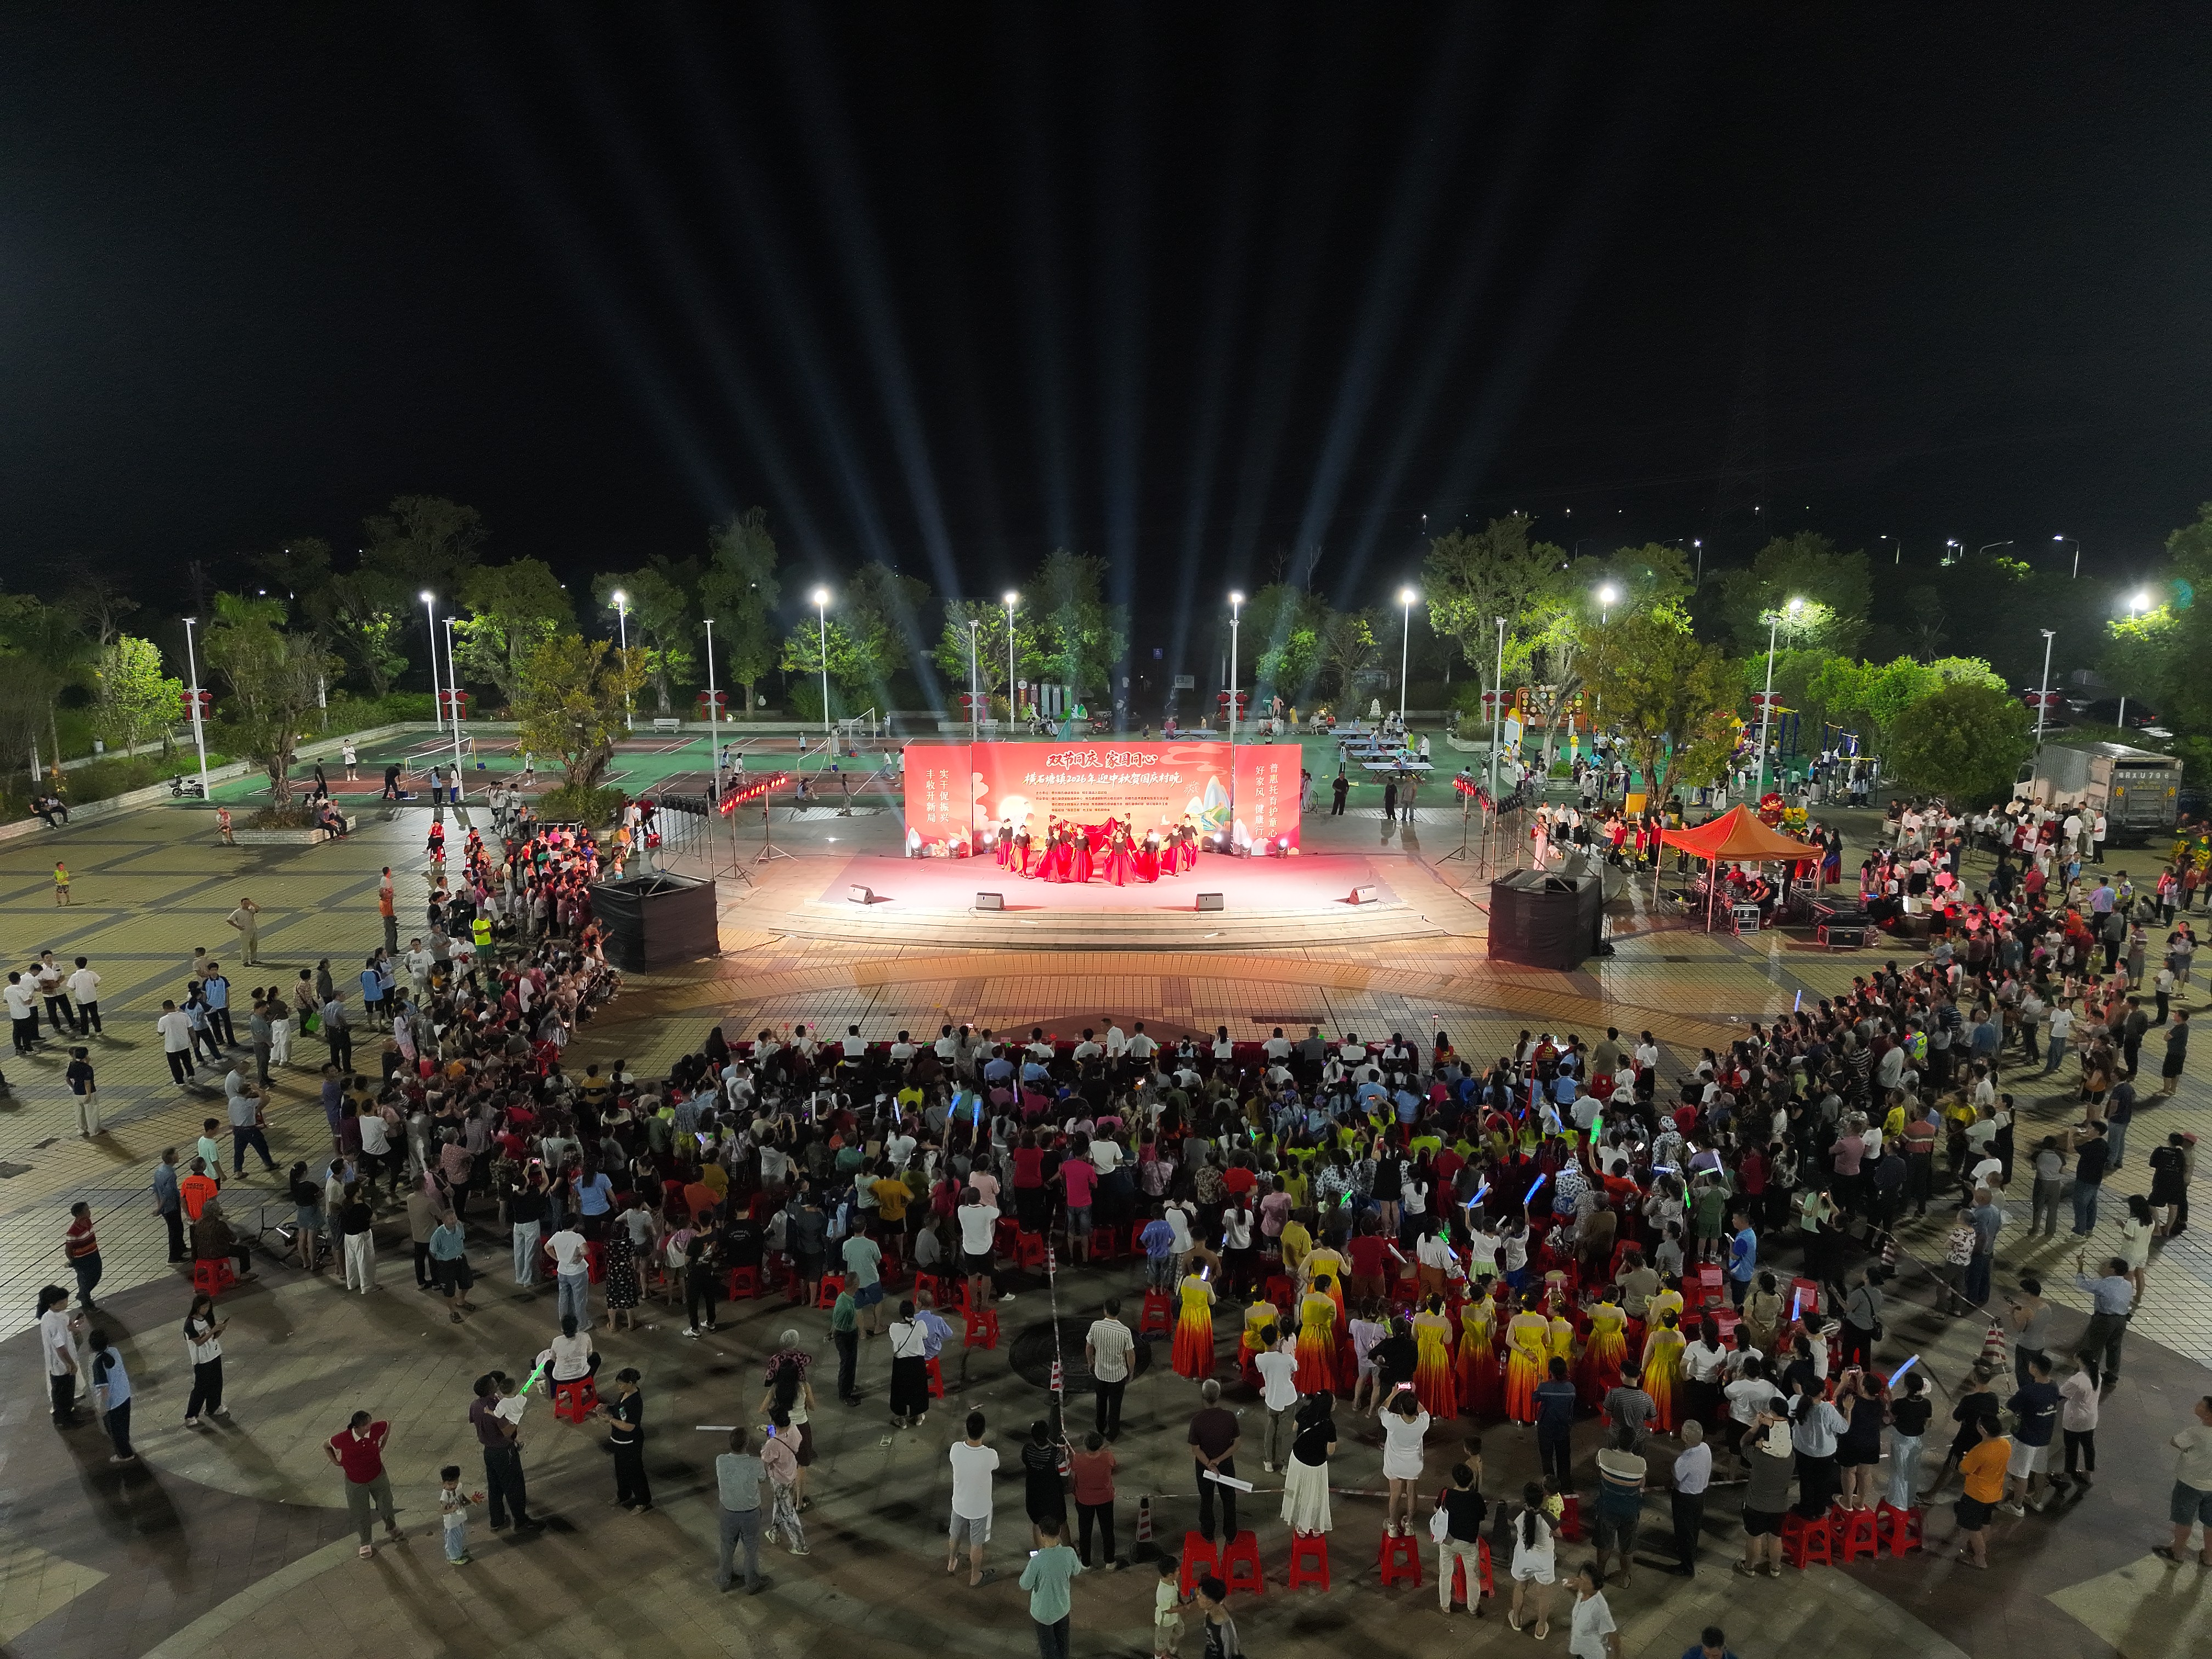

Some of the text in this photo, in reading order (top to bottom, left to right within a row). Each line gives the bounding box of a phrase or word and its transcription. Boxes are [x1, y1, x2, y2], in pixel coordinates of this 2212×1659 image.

[1022, 771, 1183, 788] 横石塘镇2026年迎中秋贺国庆村晚
[1046, 750, 1159, 770] 双节同庆 家国同心
[926, 769, 936, 823] 丰收开新局
[939, 769, 950, 823] 实干促振兴
[1255, 765, 1265, 836] 好家风·健康行
[1268, 763, 1279, 838] 普惠托育护童心
